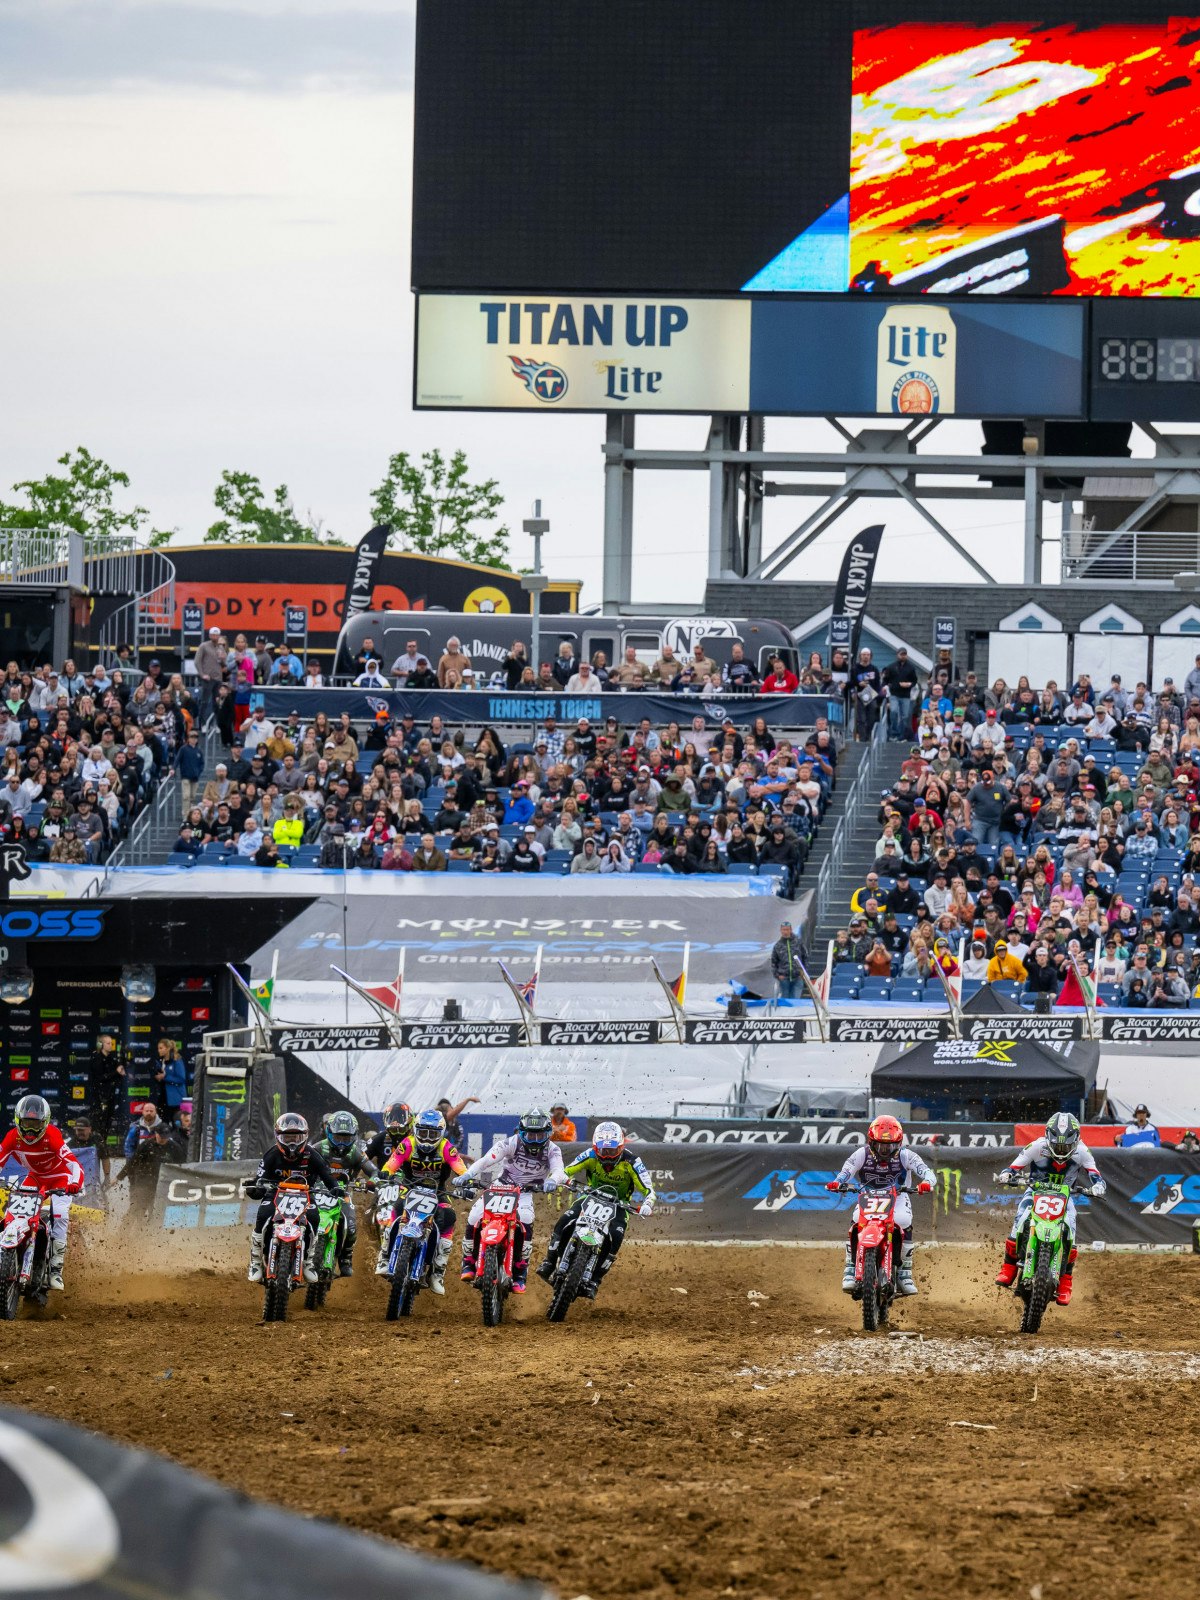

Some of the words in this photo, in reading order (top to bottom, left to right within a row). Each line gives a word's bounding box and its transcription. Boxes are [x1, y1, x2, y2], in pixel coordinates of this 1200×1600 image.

[480, 303, 613, 346] TITAN
[625, 304, 689, 347] UP
[887, 325, 947, 367] Lite
[604, 365, 662, 401] Lite
[352, 543, 379, 590] JACK
[846, 543, 874, 591] JACK
[185, 610, 201, 619] 144
[289, 611, 304, 621] 145
[832, 620, 848, 630] 145
[937, 622, 953, 632] 146
[489, 699, 555, 718] TENNESSEE
[560, 699, 601, 719] TOUGH
[425, 1025, 456, 1034] ROCKY
[458, 1024, 511, 1033] MOUNTAIN
[565, 1023, 598, 1032] ROCKY
[599, 1022, 651, 1031] MOUNTAIN
[709, 1021, 742, 1030] ROCKY
[742, 1021, 796, 1029] MOUNTAIN
[853, 1019, 884, 1028] ROCKY
[885, 1019, 940, 1028] MOUNTAIN
[987, 1019, 1019, 1028] ROCKY
[1020, 1019, 1074, 1028] MOUNTAIN
[1127, 1018, 1160, 1027] ROCKY
[296, 1029, 329, 1038] ROCKY
[330, 1028, 380, 1037] MOUNTAIN
[378, 1185, 400, 1206] 208
[404, 1193, 438, 1214] 75
[278, 1196, 308, 1216] 435
[485, 1195, 516, 1214] 48
[583, 1200, 613, 1222] 108
[864, 1198, 893, 1213] 37
[1034, 1197, 1064, 1214] 63
